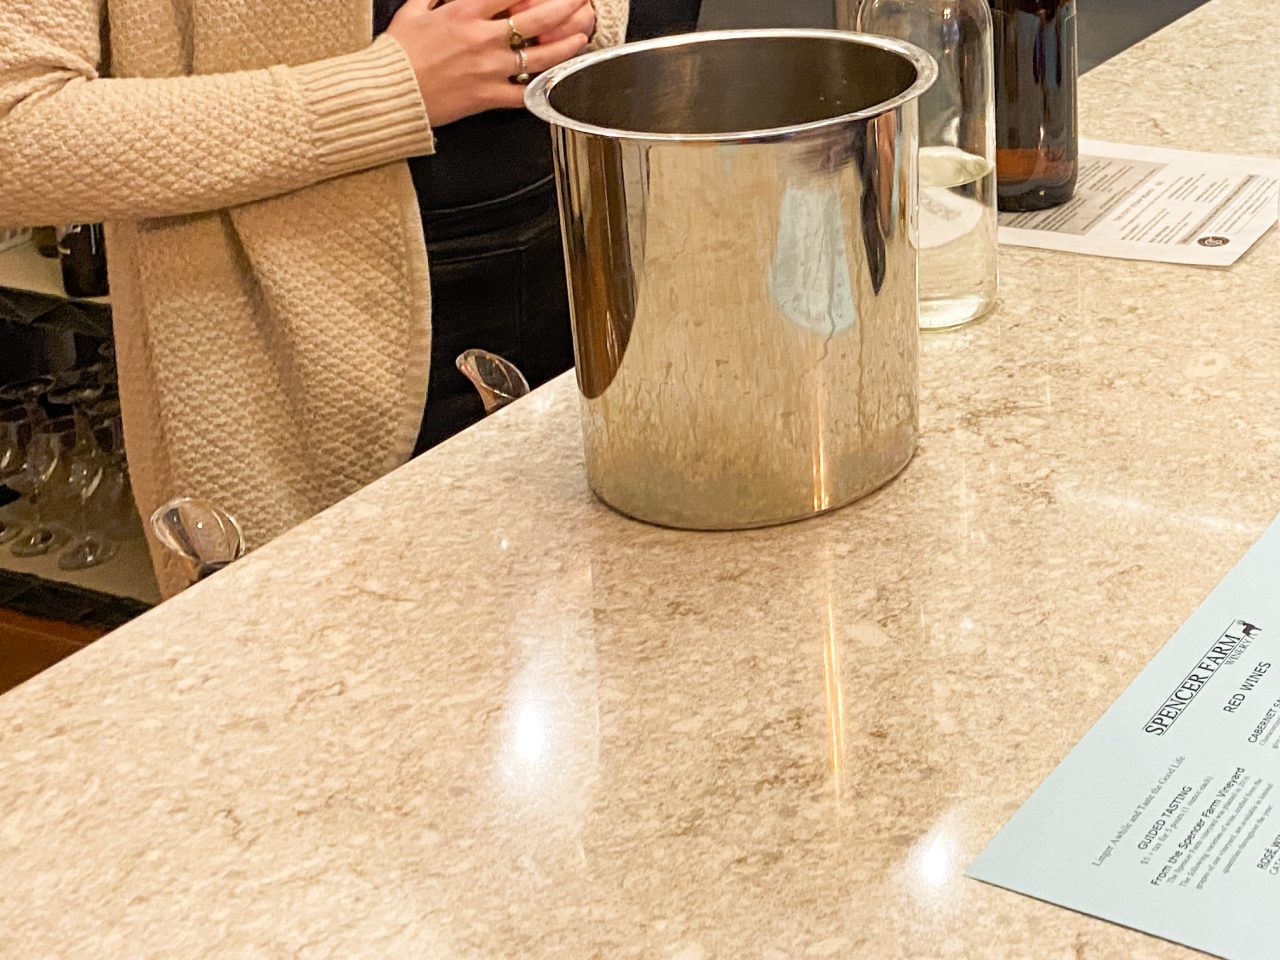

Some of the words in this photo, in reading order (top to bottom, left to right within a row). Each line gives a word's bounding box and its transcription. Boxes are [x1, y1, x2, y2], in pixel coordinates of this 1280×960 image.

[1225, 639, 1252, 664] WINERY
[1145, 674, 1209, 735] SPENCER
[1198, 634, 1240, 672] FARM
[1223, 694, 1245, 713] RED
[1240, 662, 1271, 690] WINES
[1248, 708, 1277, 743] CABERNET
[1111, 823, 1132, 845] Awhile
[1130, 810, 1142, 822] and
[1137, 795, 1155, 810] Taste
[1151, 785, 1162, 794] the
[1158, 768, 1176, 784] Good
[1171, 756, 1185, 768] Life
[1138, 820, 1165, 849] GUIDED
[1161, 786, 1192, 817] TASTING
[1151, 865, 1172, 885] From
[1168, 851, 1183, 864] the
[1178, 819, 1205, 849] Spencer
[1202, 800, 1221, 817] Farm
[1216, 767, 1245, 797] Vineyard
